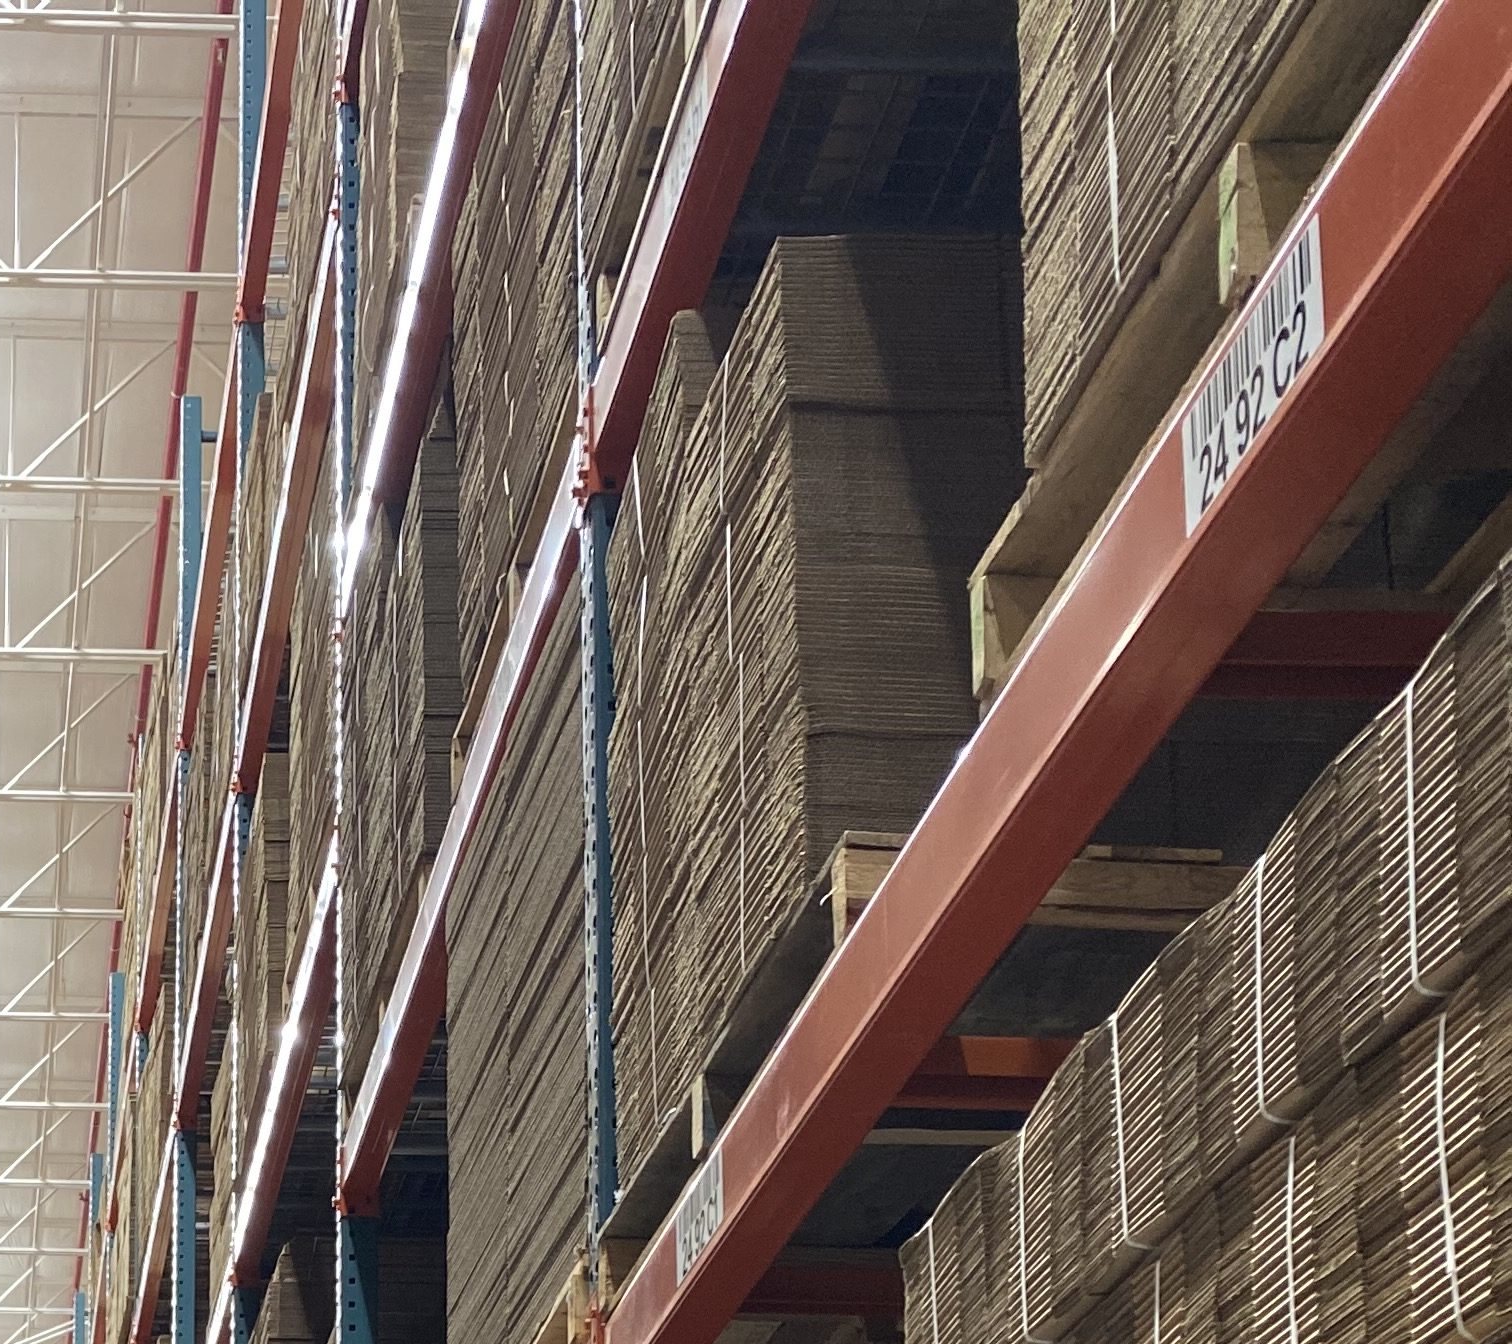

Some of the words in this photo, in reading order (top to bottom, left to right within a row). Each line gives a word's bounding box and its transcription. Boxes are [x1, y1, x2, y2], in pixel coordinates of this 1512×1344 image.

[1199, 418, 1229, 515] 24
[1235, 364, 1266, 456] 92
[1273, 300, 1309, 398] C2
[682, 1227, 693, 1277] 24
[694, 1209, 705, 1257] 92
[708, 1188, 718, 1236] C1
